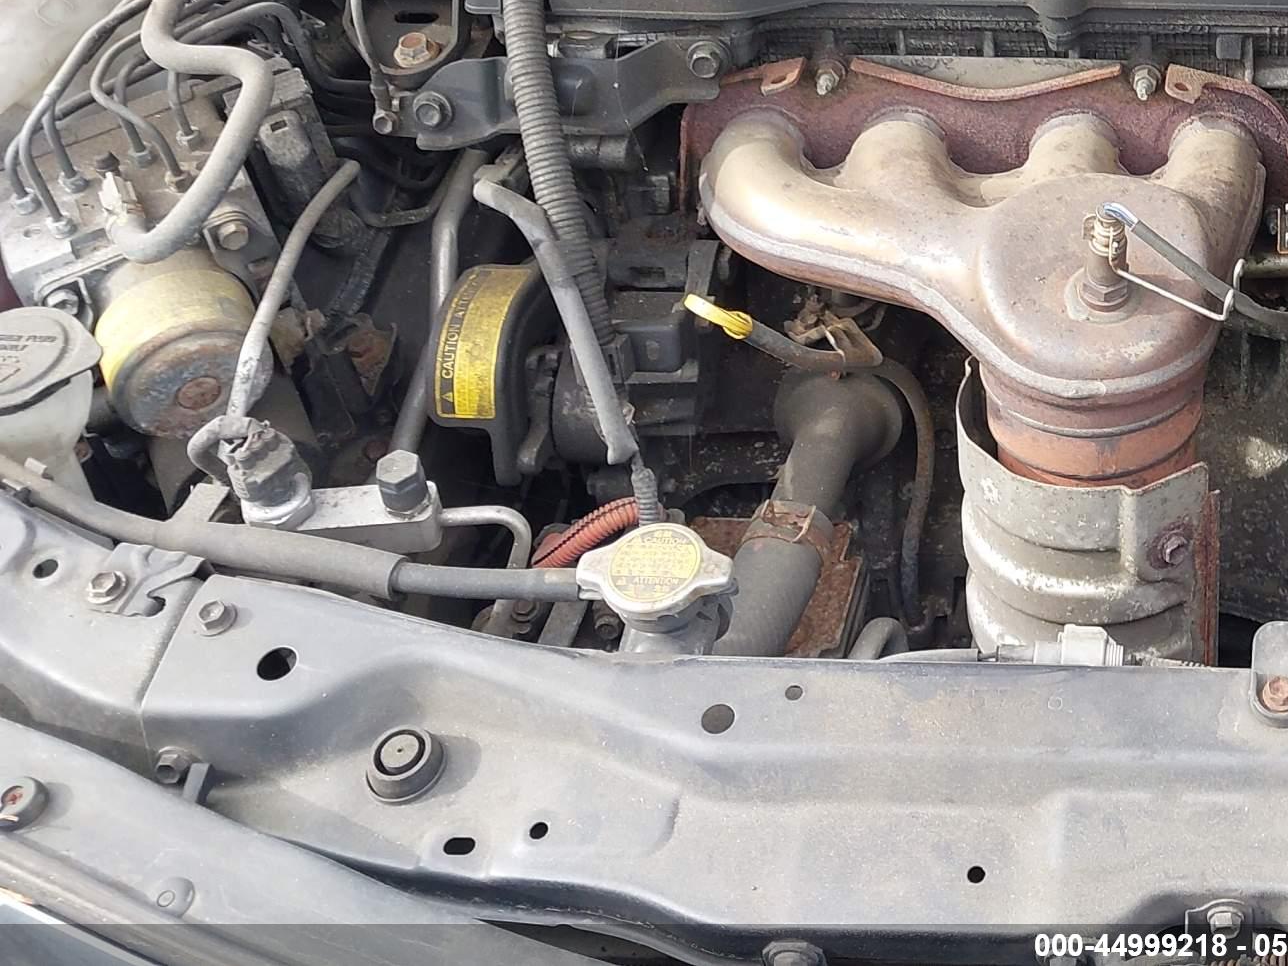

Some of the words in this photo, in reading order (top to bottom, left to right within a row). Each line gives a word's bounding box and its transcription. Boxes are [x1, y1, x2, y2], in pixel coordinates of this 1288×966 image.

[441, 323, 460, 379] CAUTION
[644, 537, 687, 545] CAUTION
[633, 577, 681, 586] ATTENTION
